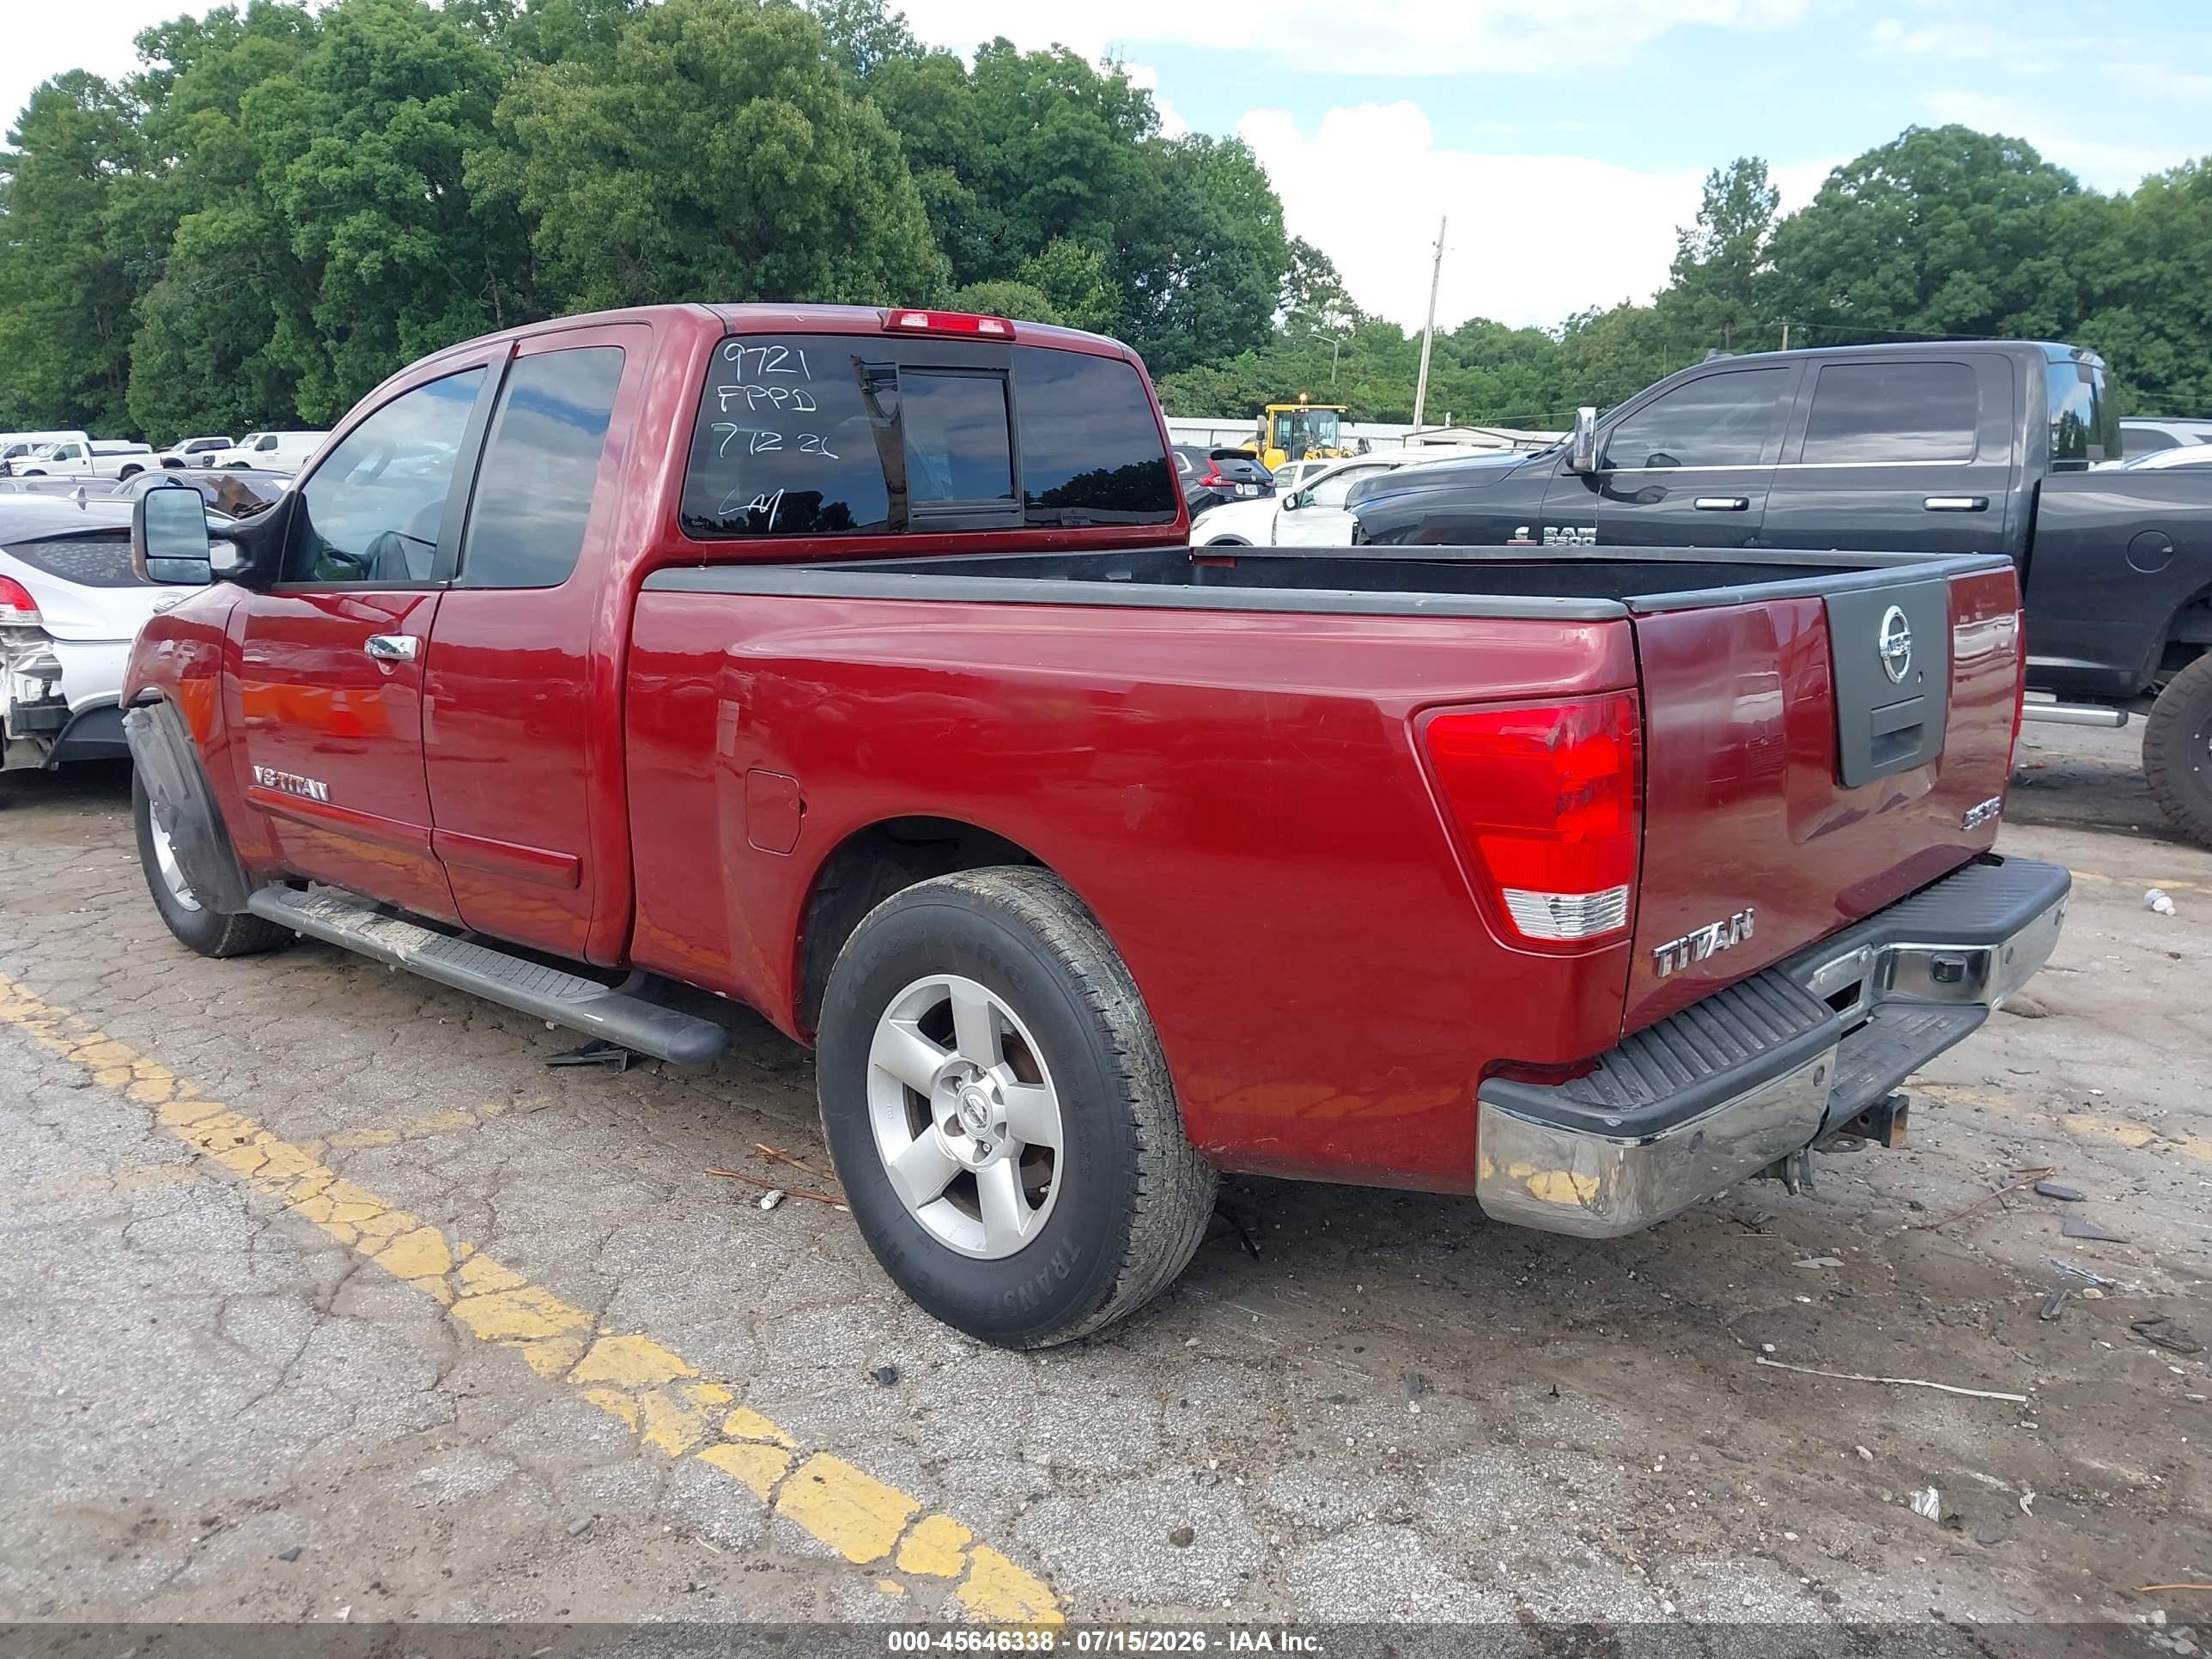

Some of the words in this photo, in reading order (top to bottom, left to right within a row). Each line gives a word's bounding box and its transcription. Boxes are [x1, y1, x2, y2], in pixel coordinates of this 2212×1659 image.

[724, 343, 811, 383] 9721
[1543, 526, 1598, 537] RAM
[1543, 536, 1597, 546] 2500
[1652, 907, 1755, 977] TITAN
